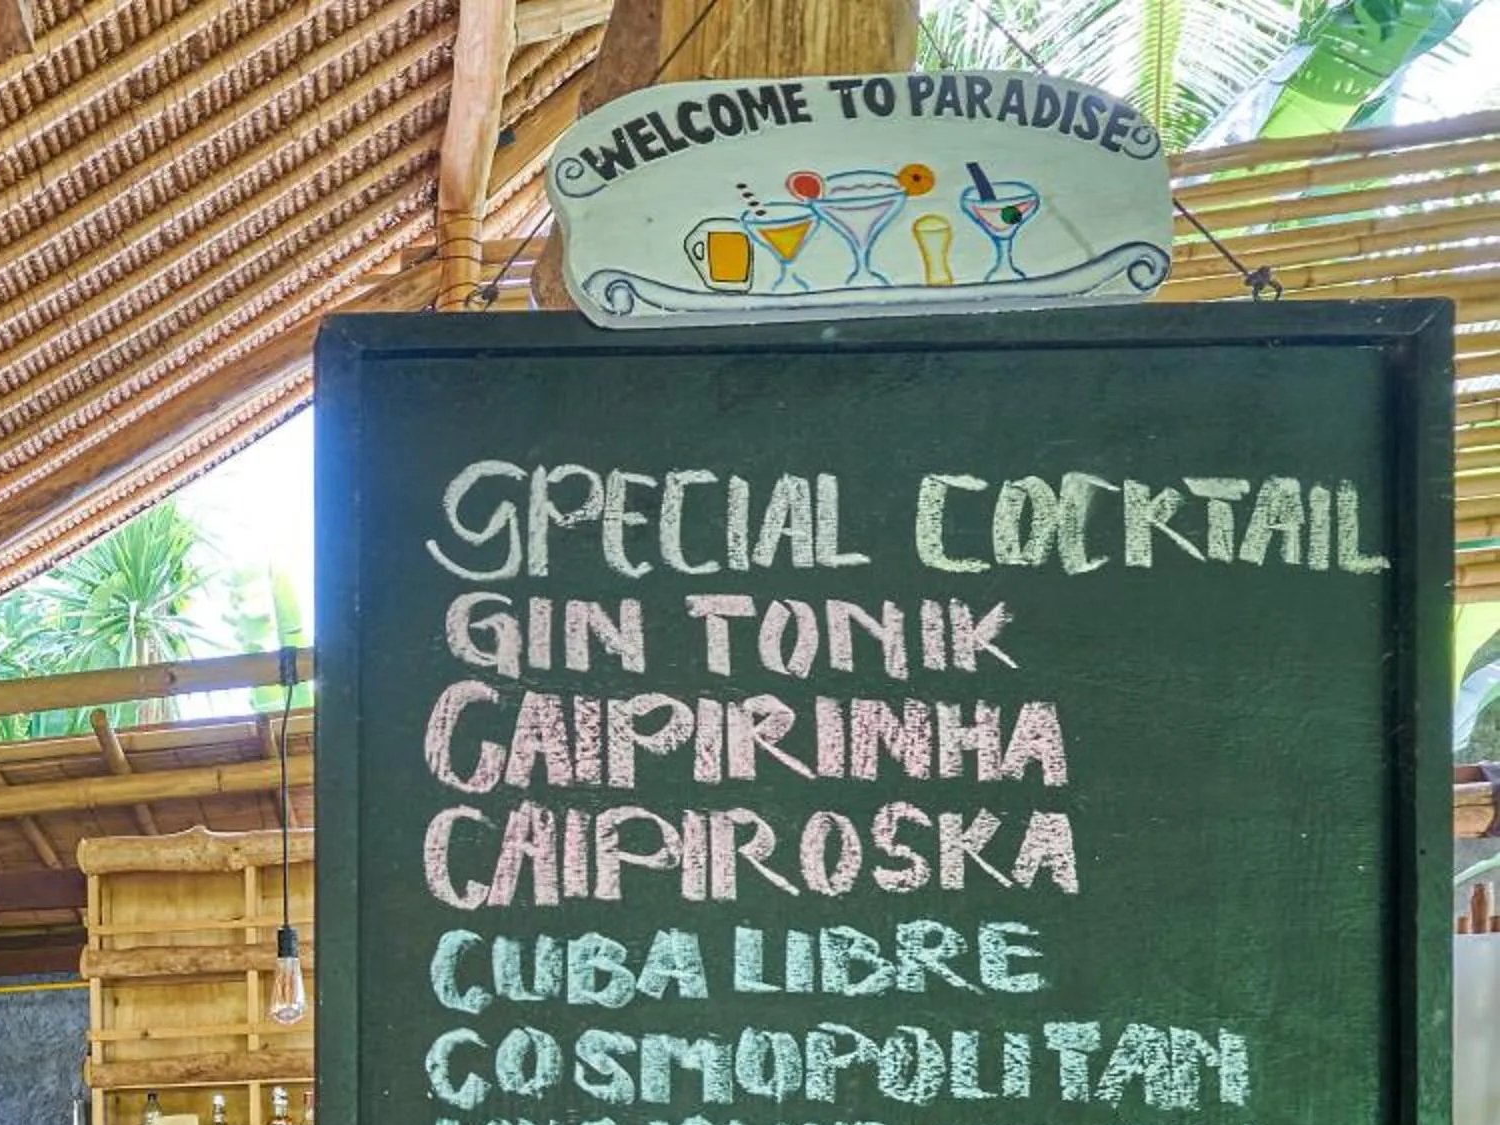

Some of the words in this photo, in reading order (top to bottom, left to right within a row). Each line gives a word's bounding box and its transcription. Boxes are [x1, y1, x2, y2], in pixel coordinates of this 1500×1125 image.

[579, 82, 812, 180] WELCOME
[829, 78, 896, 120] TO
[907, 75, 1140, 153] PARADISE
[425, 460, 872, 580] SPECIAL
[914, 472, 1390, 574] COCKTAIL
[445, 593, 645, 679] GIN
[685, 595, 1019, 679] TONIK
[424, 680, 1069, 794] CAIPIRINHA
[423, 800, 1079, 911] CAIPIROSKA
[429, 929, 709, 1012] CUBA
[733, 920, 1046, 996] LIBRE
[425, 1020, 1253, 1110] COSMOPOLITAN
